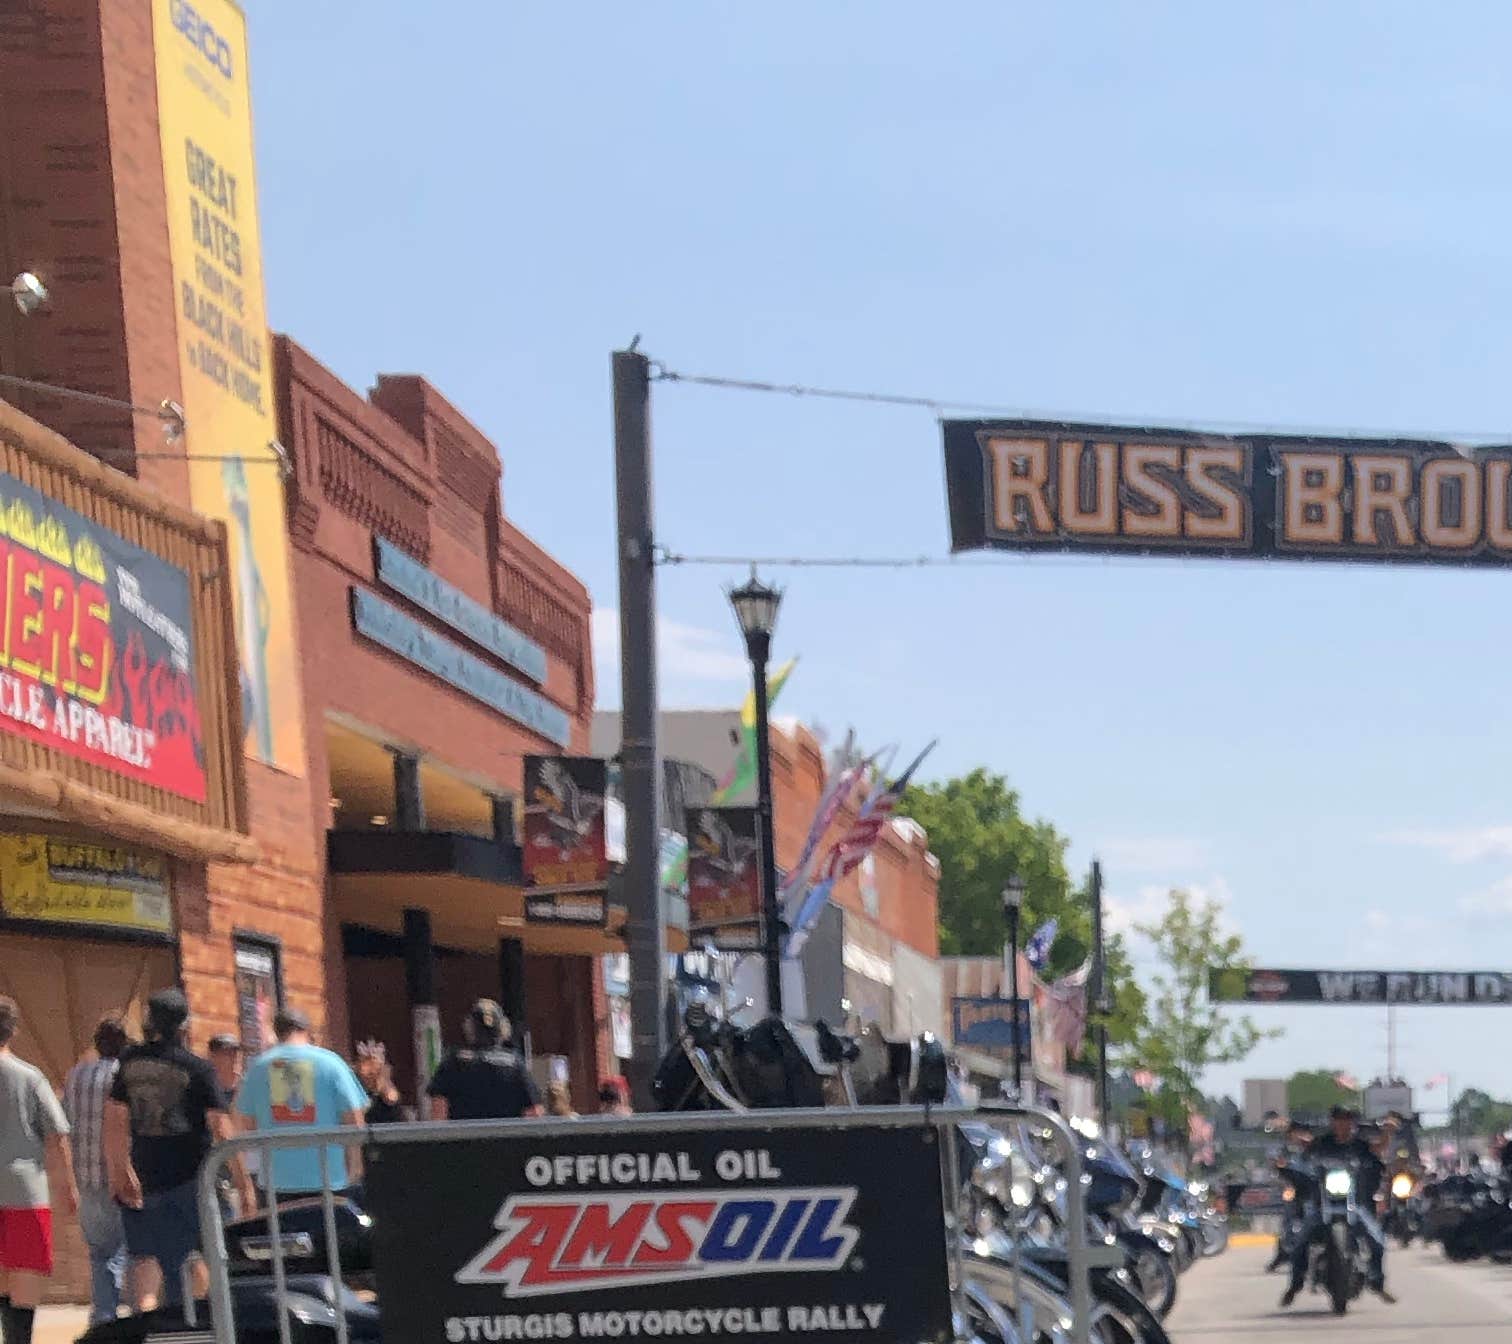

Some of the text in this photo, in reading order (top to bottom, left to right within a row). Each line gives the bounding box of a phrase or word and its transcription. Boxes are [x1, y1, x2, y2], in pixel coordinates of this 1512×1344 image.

[184, 136, 237, 220] GREAT
[189, 194, 242, 277] RATES
[989, 435, 1244, 541] RUSS
[0, 537, 114, 704] ERS
[525, 1149, 781, 1186] OFFICIAL OIL
[480, 1198, 847, 1287] AMSOIL
[445, 1303, 885, 1342] STURGIS MOTORCYCLE RALLY
